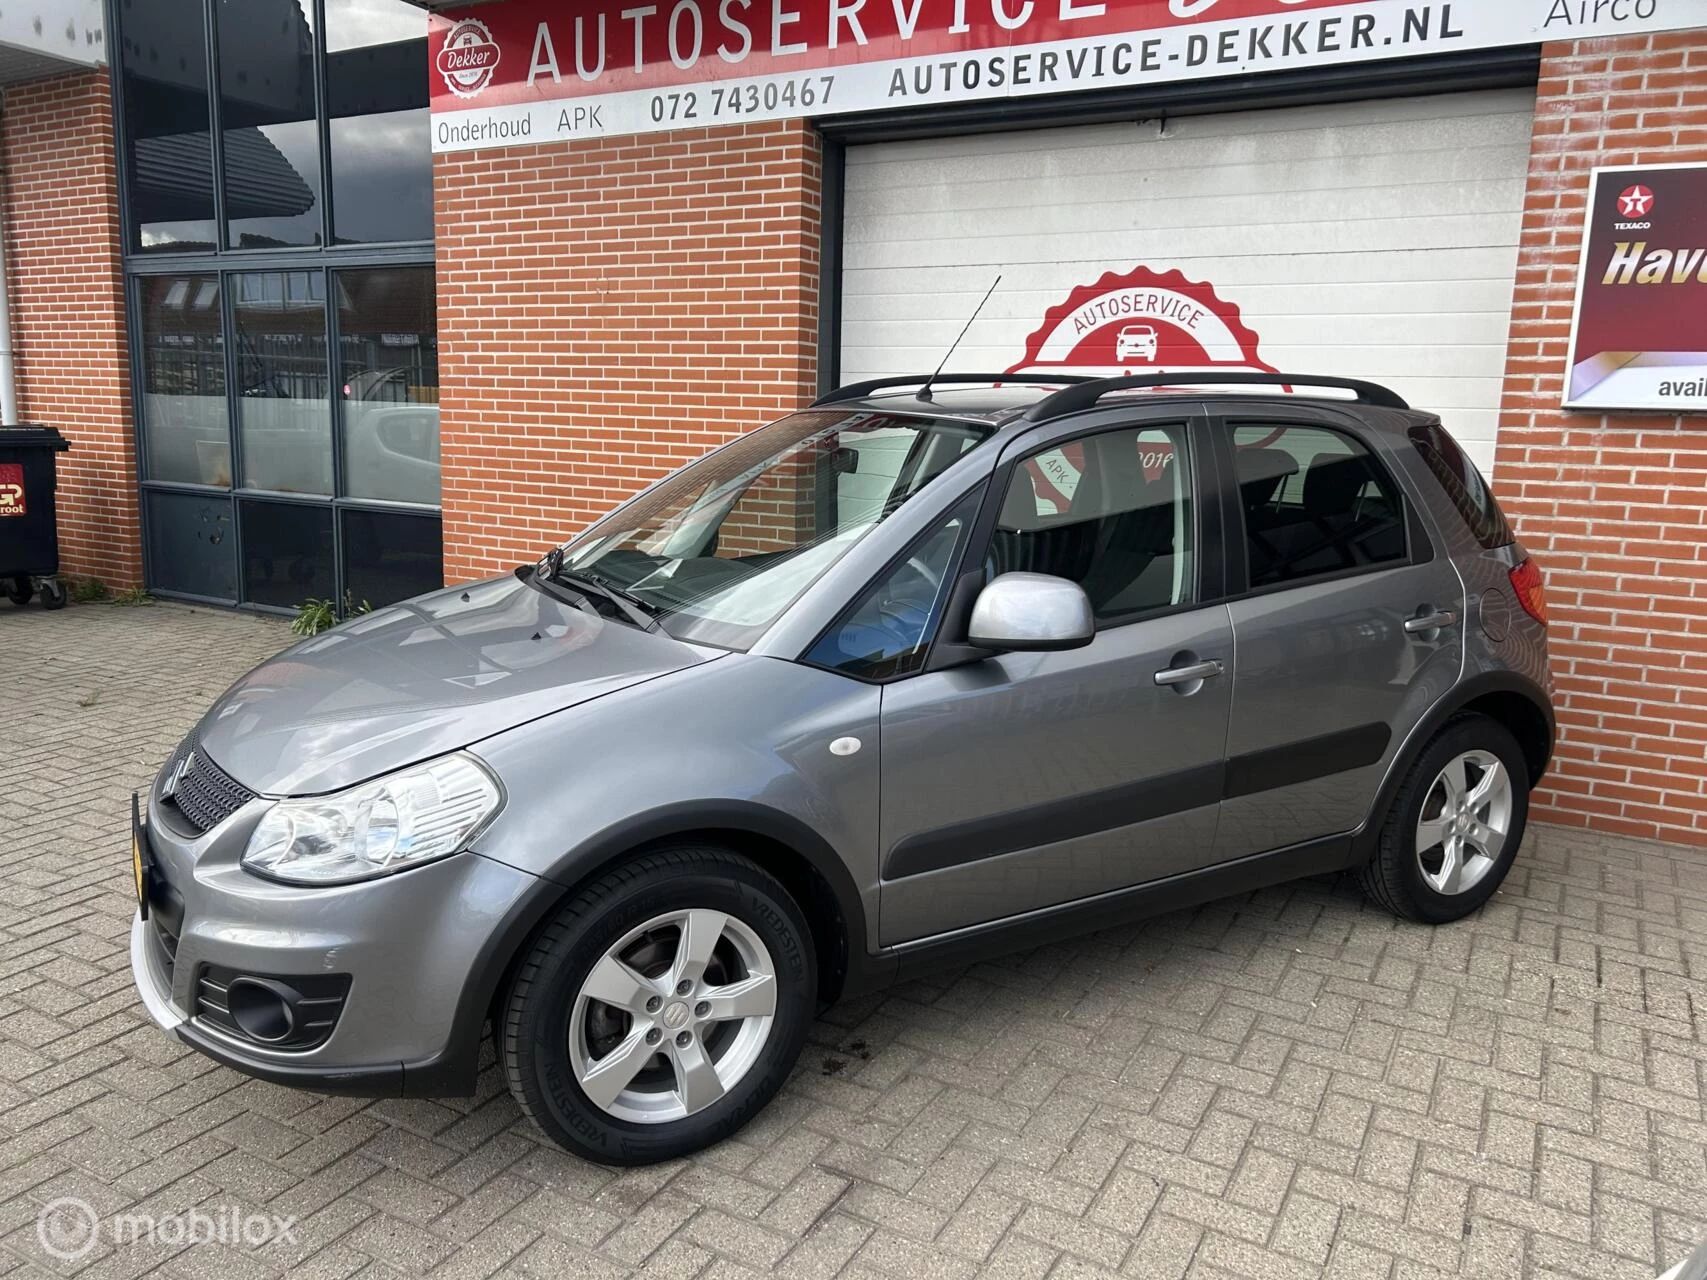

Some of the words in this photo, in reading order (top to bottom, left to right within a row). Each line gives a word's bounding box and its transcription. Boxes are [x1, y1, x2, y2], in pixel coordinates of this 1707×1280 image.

[447, 48, 490, 69] Dekker
[438, 111, 531, 145] Onderhoud
[557, 104, 603, 132] APK
[650, 95, 698, 122] 072
[711, 76, 835, 116] 7430467
[888, 4, 1464, 97] AUTOSERVICE-DEKKER.NL
[1543, 0, 1656, 27] Airco
[1614, 222, 1651, 230] TEXACO
[1073, 294, 1205, 335] AUTOSERVICE
[1045, 457, 1070, 484] APK
